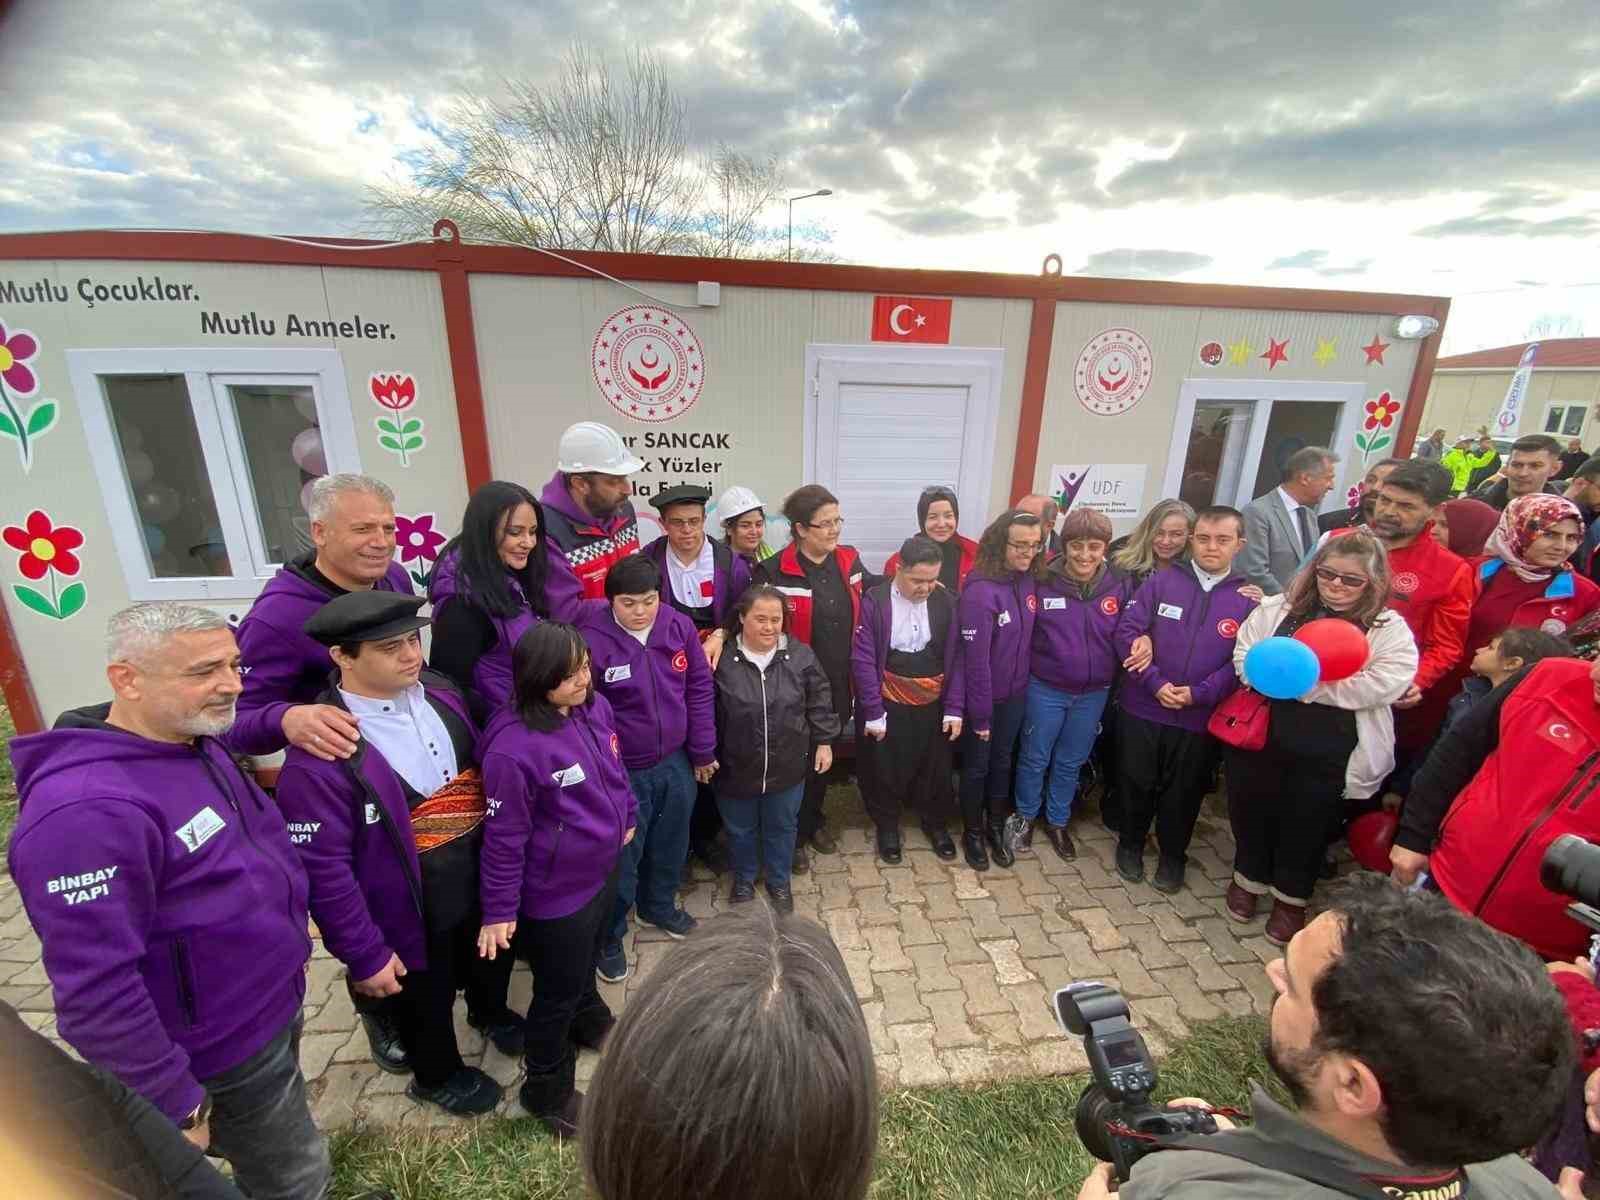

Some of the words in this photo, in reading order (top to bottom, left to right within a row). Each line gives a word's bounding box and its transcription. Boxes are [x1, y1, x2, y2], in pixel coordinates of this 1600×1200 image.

[0, 278, 69, 304] Mutlu
[77, 276, 200, 309] Çocuklar.
[200, 311, 276, 336] Mutlu
[286, 313, 396, 340] Anneler.
[644, 431, 730, 449] SANCAK
[658, 456, 723, 473] Yüzler
[1093, 480, 1122, 495] UDF
[287, 822, 322, 833] NBAY
[290, 834, 312, 844] API
[63, 883, 110, 906] YAPI
